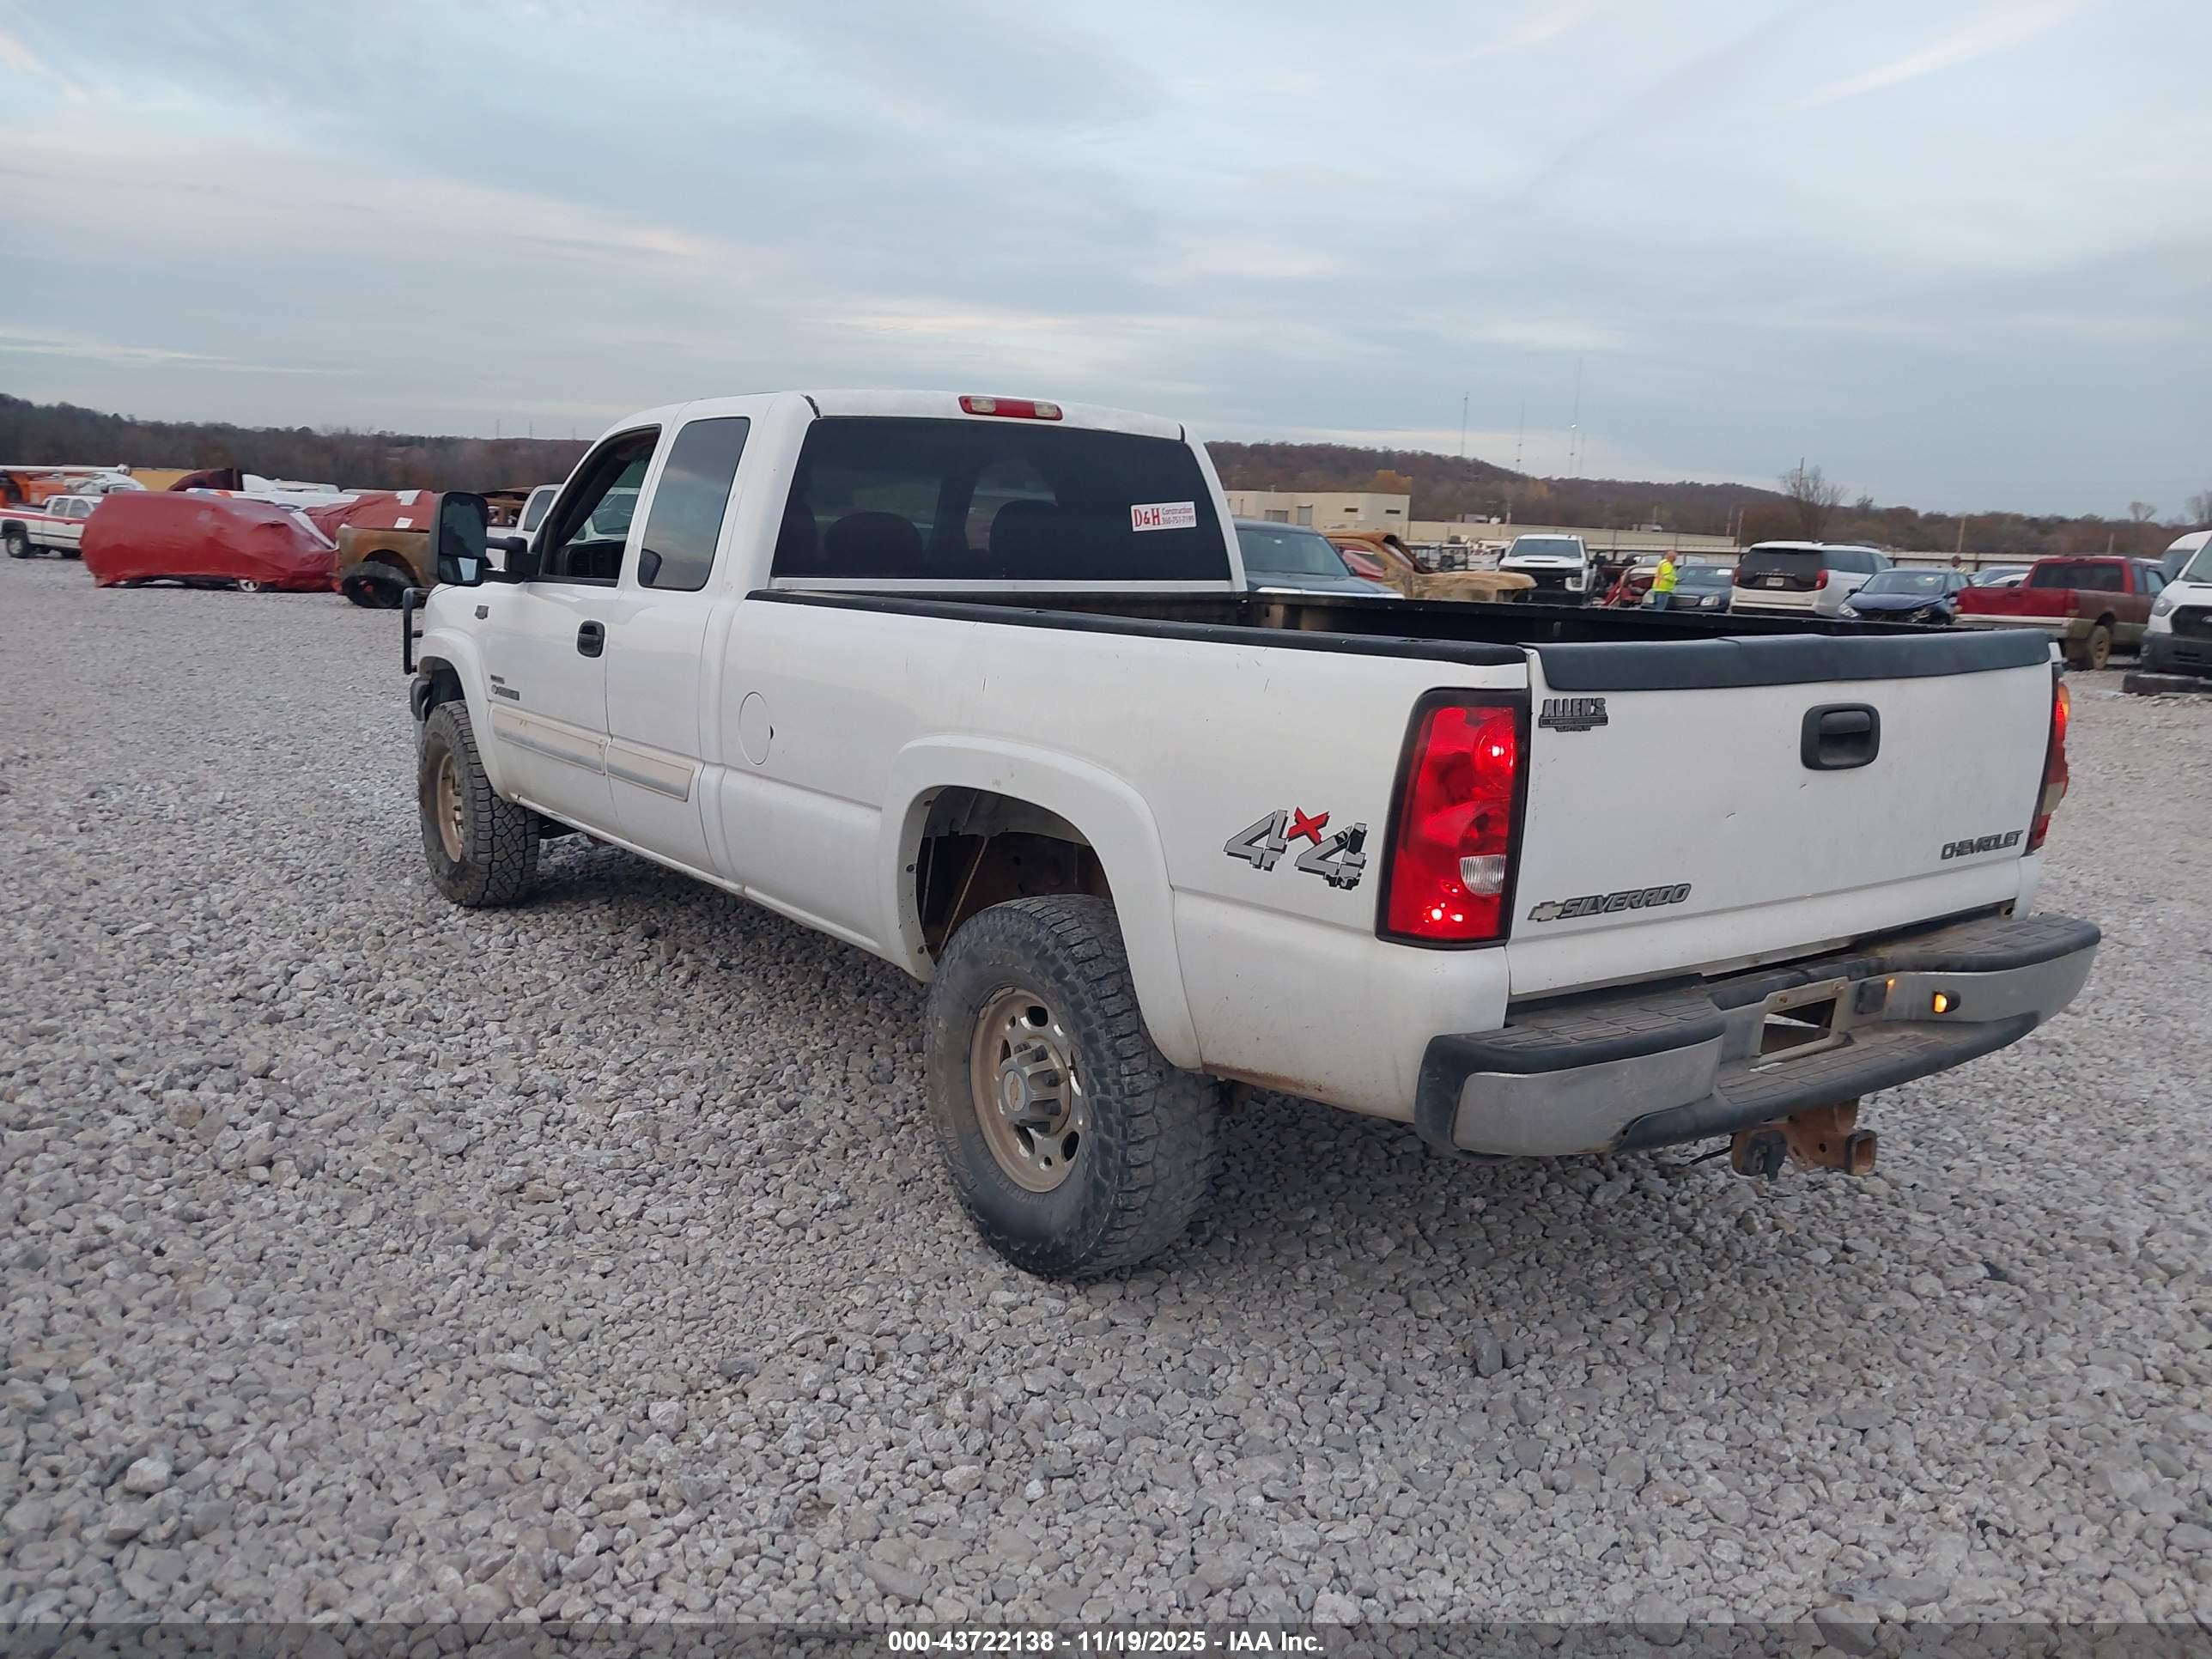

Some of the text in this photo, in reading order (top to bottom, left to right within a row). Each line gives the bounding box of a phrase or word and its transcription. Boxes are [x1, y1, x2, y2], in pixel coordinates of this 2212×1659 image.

[1133, 507, 1161, 527] D&H
[1541, 697, 1607, 717] ALLEN'S
[1941, 830, 2024, 860] CHEVROLET
[1556, 883, 1692, 920] SILVERADO
